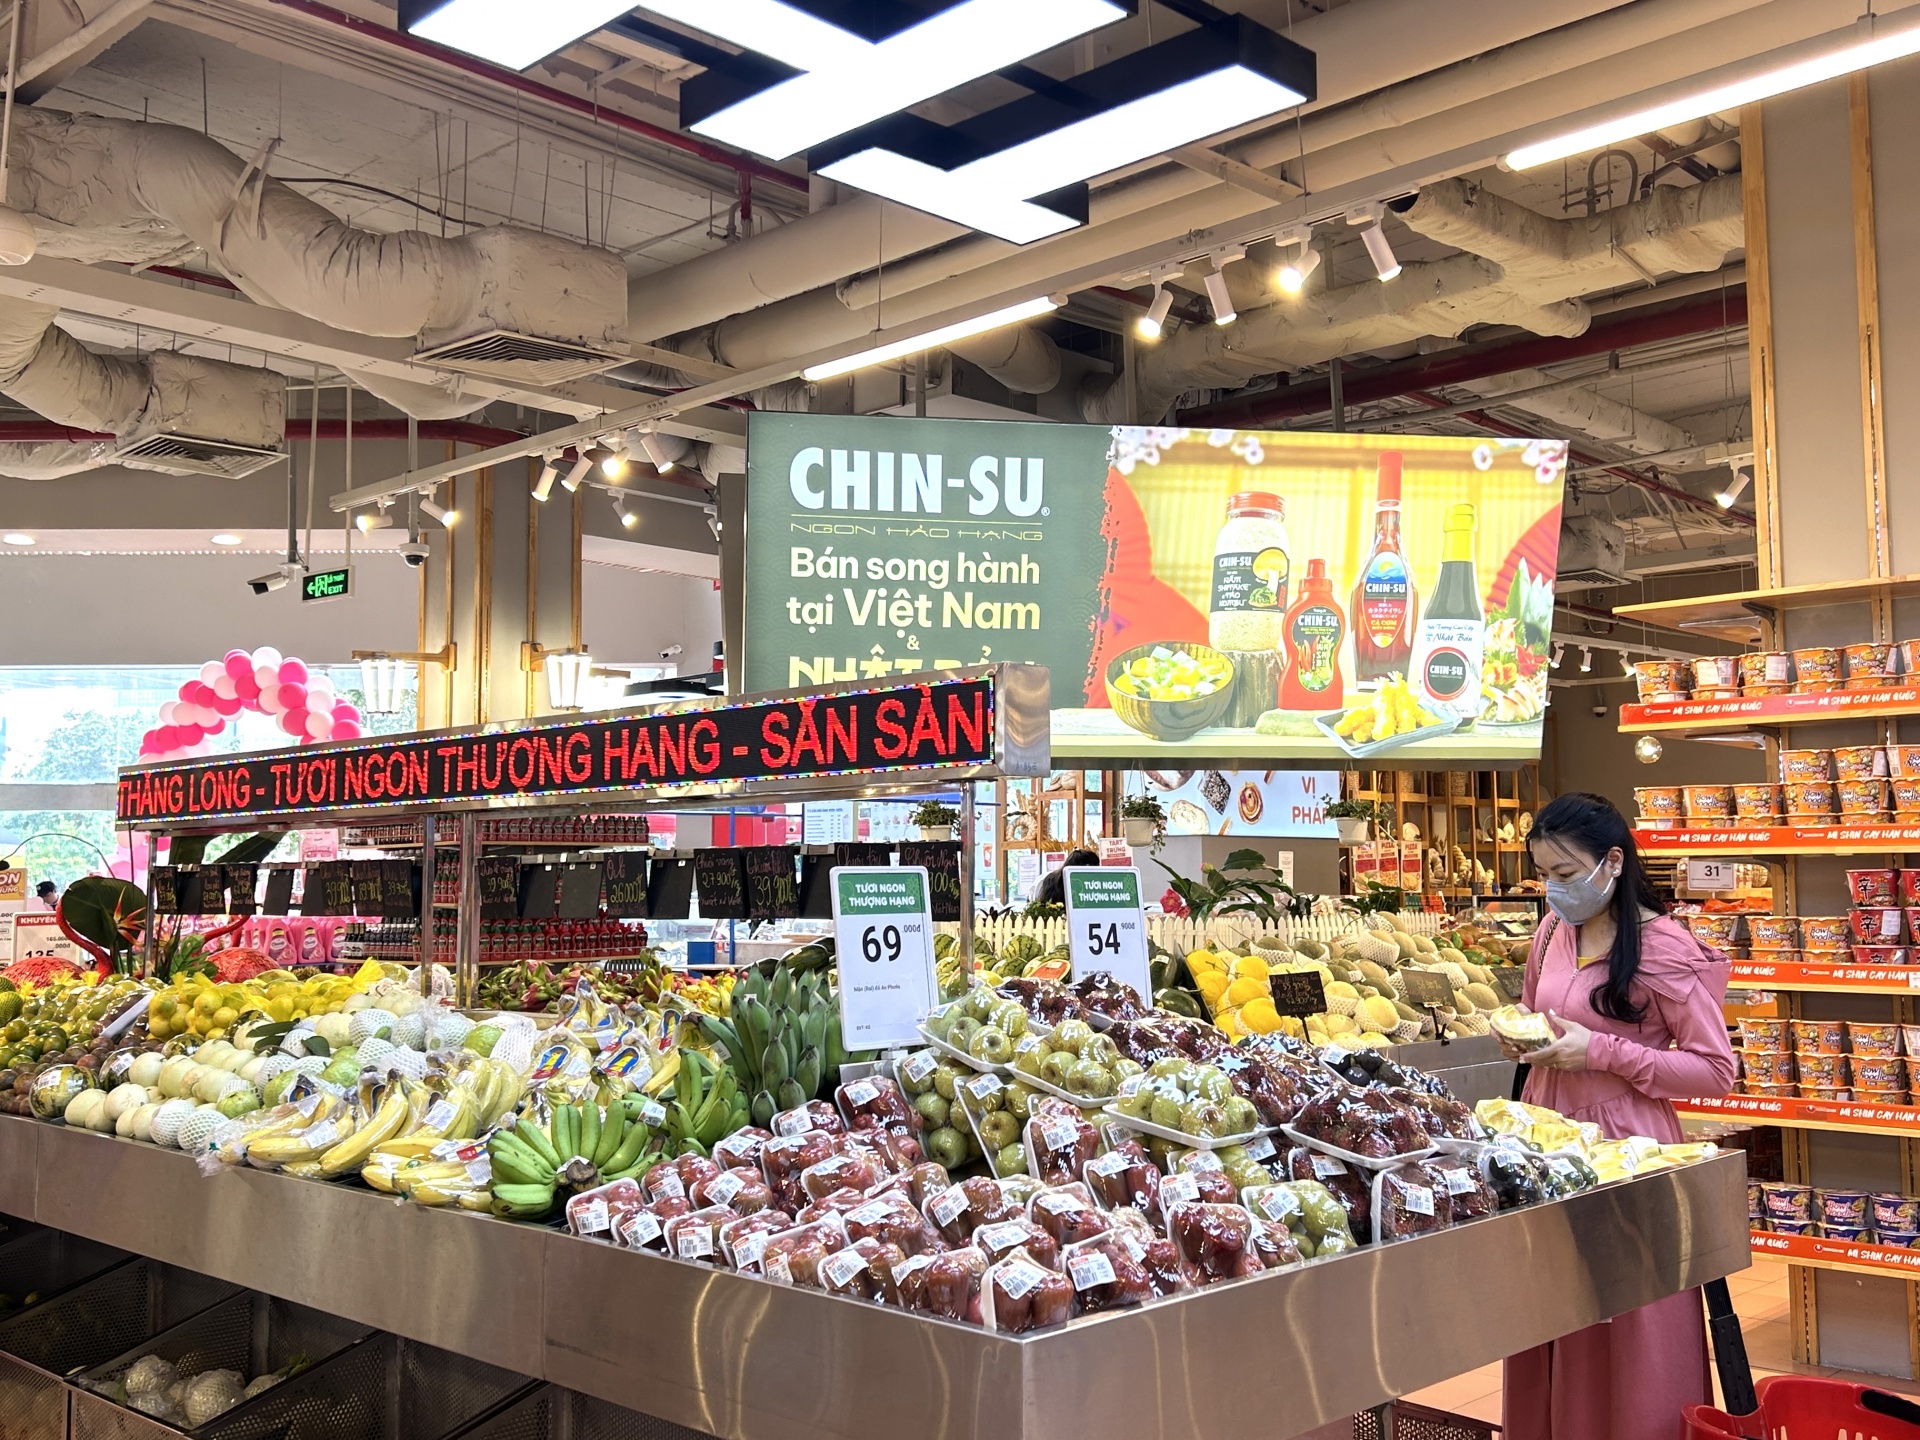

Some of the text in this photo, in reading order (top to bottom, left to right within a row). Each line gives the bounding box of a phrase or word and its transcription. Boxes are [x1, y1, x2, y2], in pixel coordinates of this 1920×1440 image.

[789, 447, 1044, 516] CHIN-SU
[791, 523, 875, 535] NGON
[791, 546, 1040, 589] Bán song hành
[328, 584, 343, 595] EXIT
[1366, 583, 1406, 593] CHIN-SU
[786, 587, 1041, 639] tại Việt Nam
[1298, 615, 1338, 626] CHIN-SU
[906, 635, 920, 650] &
[189, 767, 250, 813] LONG
[271, 759, 337, 805] TƯƠI
[345, 750, 429, 801] NGON
[604, 718, 721, 785] HẠNG
[1301, 775, 1316, 799] VỊ
[1704, 865, 1720, 877] 31
[855, 882, 906, 894] TƯƠI NGON
[1084, 879, 1124, 890] TƯƠI NGON
[849, 896, 916, 908] THƯỢNG HẠNG
[1079, 892, 1131, 903] THƯỢNG HẠNG
[862, 924, 902, 963] 69
[1088, 922, 1121, 955] 54
